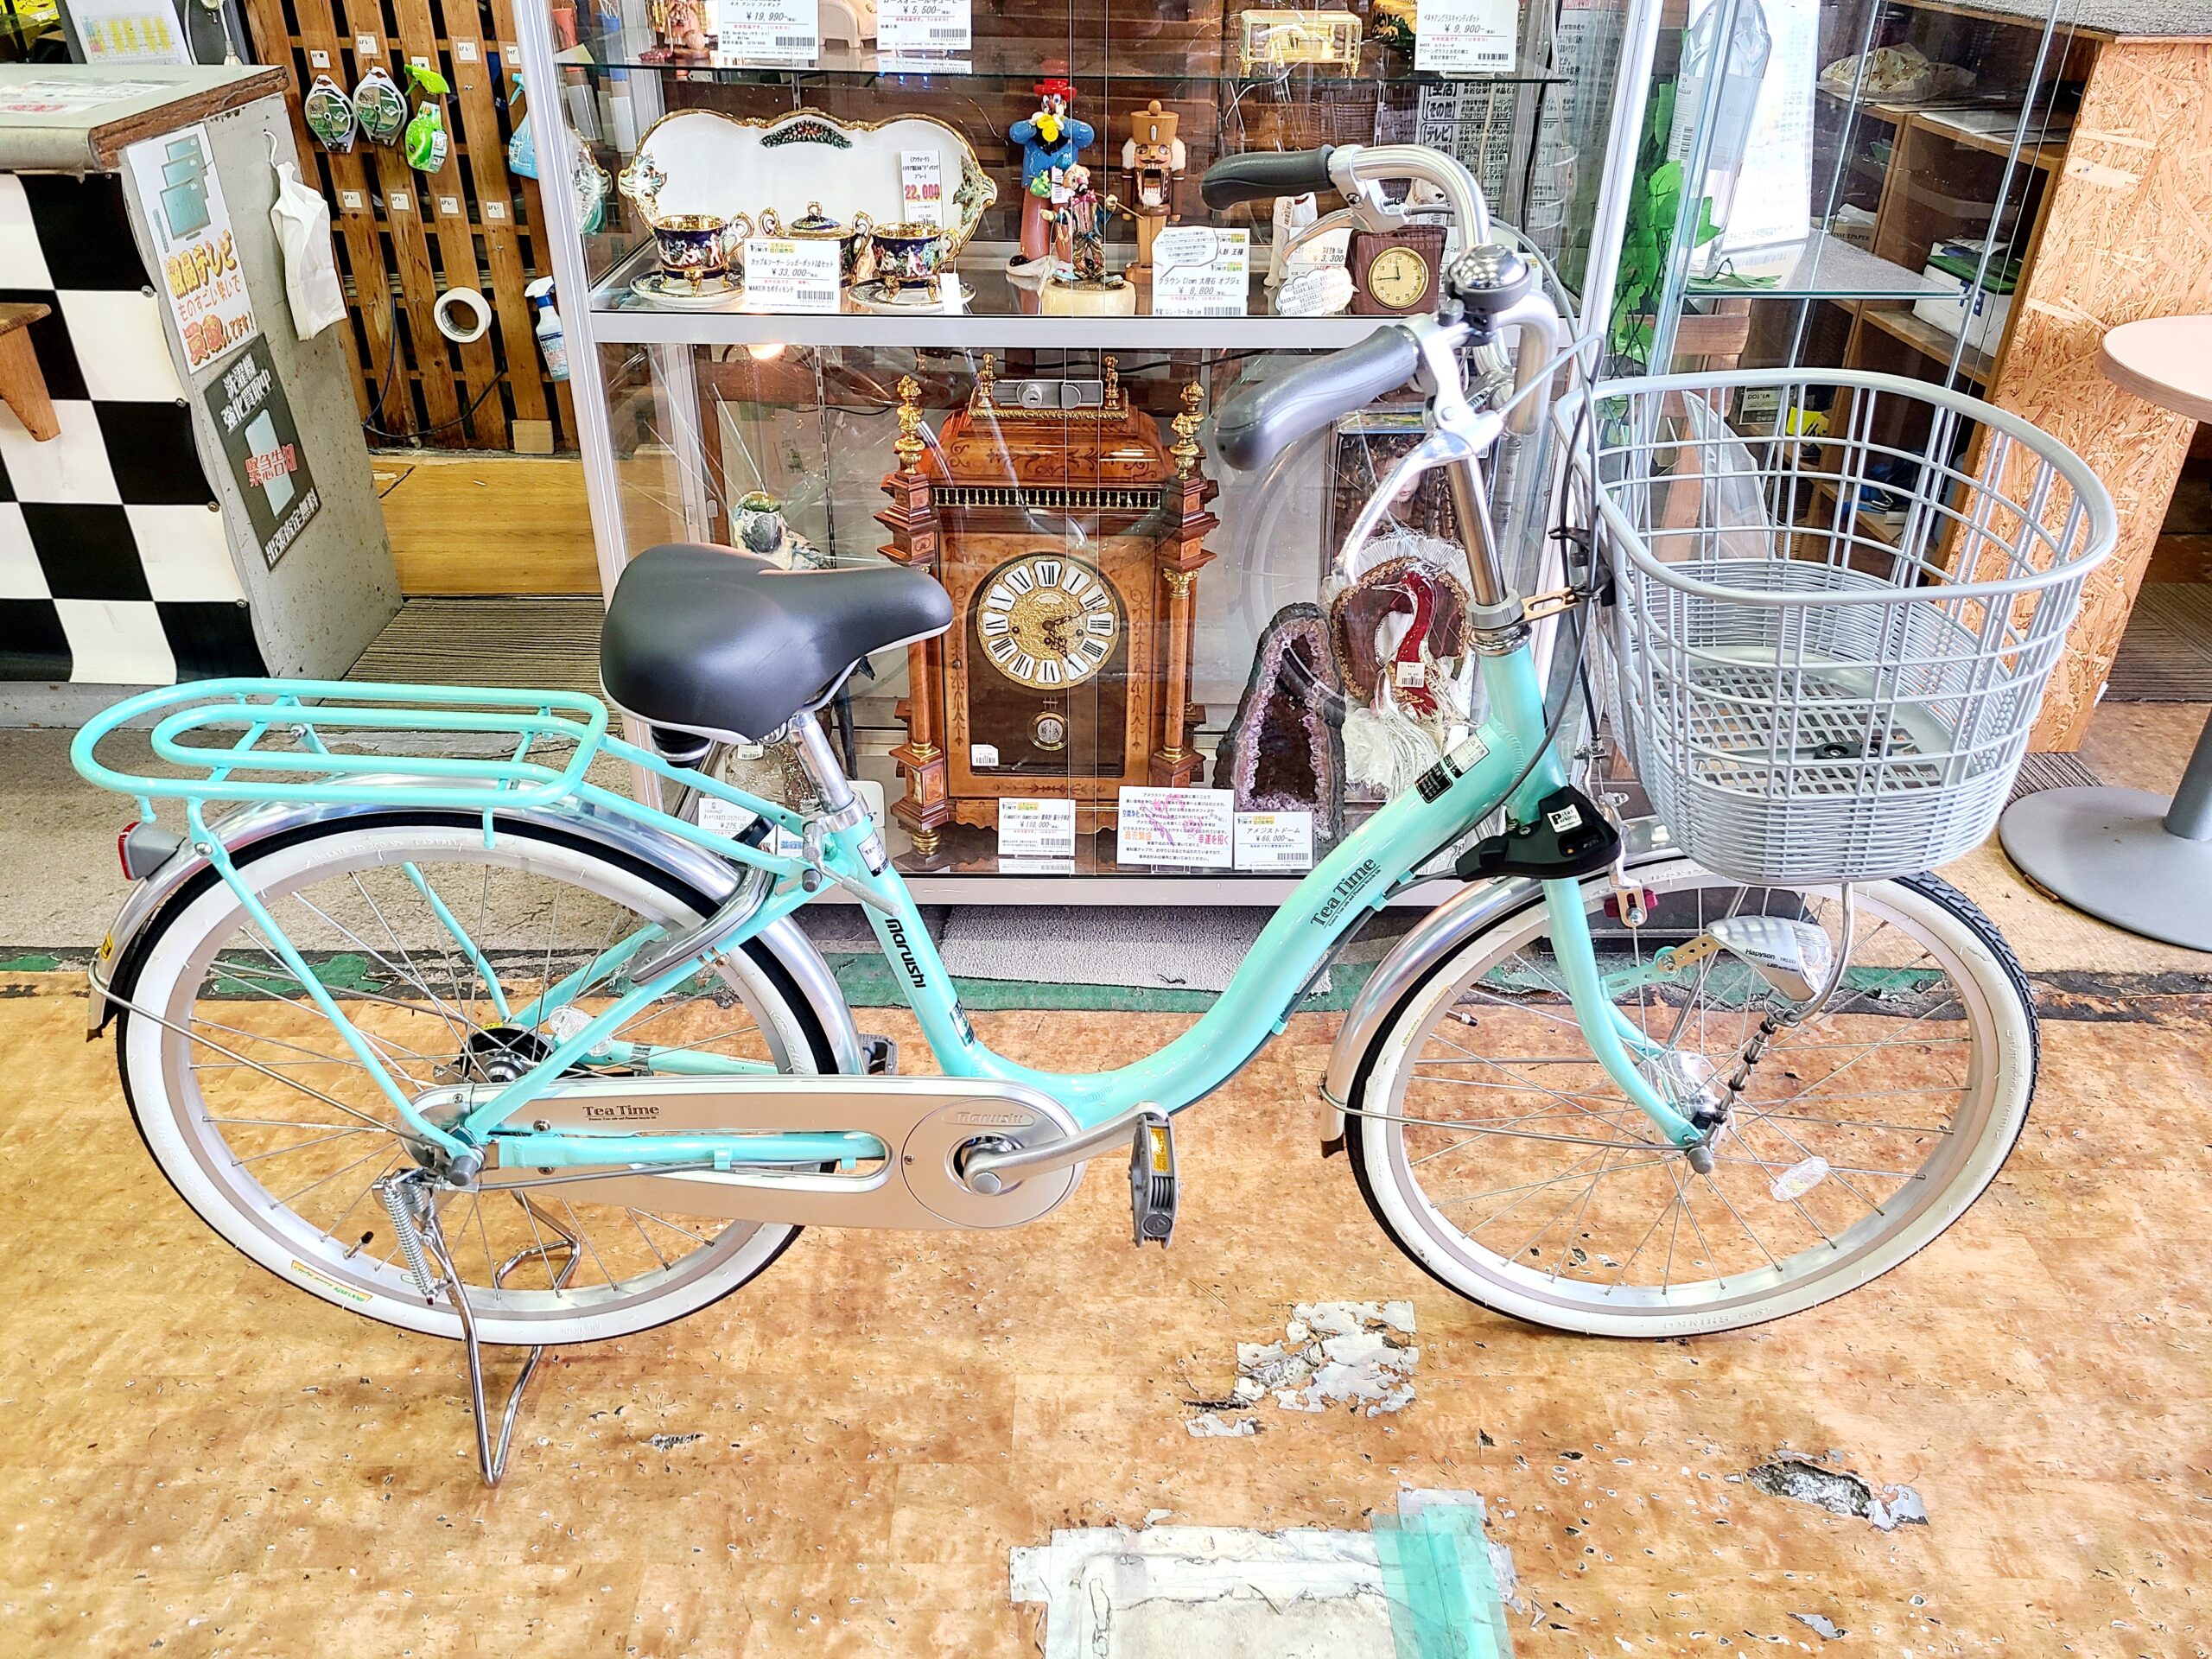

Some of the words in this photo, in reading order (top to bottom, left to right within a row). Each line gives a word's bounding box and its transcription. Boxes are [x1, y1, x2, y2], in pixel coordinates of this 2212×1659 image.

[1426, 100, 1457, 119] 【その他】
[1423, 124, 1454, 143] 【テレビ】
[905, 183, 940, 201] 22,000
[1158, 276, 1181, 285] クラウン
[1218, 276, 1241, 285] オブジェ
[178, 276, 241, 321] ものすごい勢いで
[222, 353, 257, 400] 洗濯機
[220, 368, 271, 433] 強化買取中
[245, 443, 297, 487] 緊急告知
[264, 487, 320, 564] 出張査定無料
[1198, 834, 1230, 846] 幸運を招く
[1310, 897, 1341, 925] Tea
[1333, 859, 1376, 896] Time
[1745, 948, 1775, 960] Hapyson
[582, 1106, 615, 1116] Tea
[616, 1105, 660, 1115] Time
